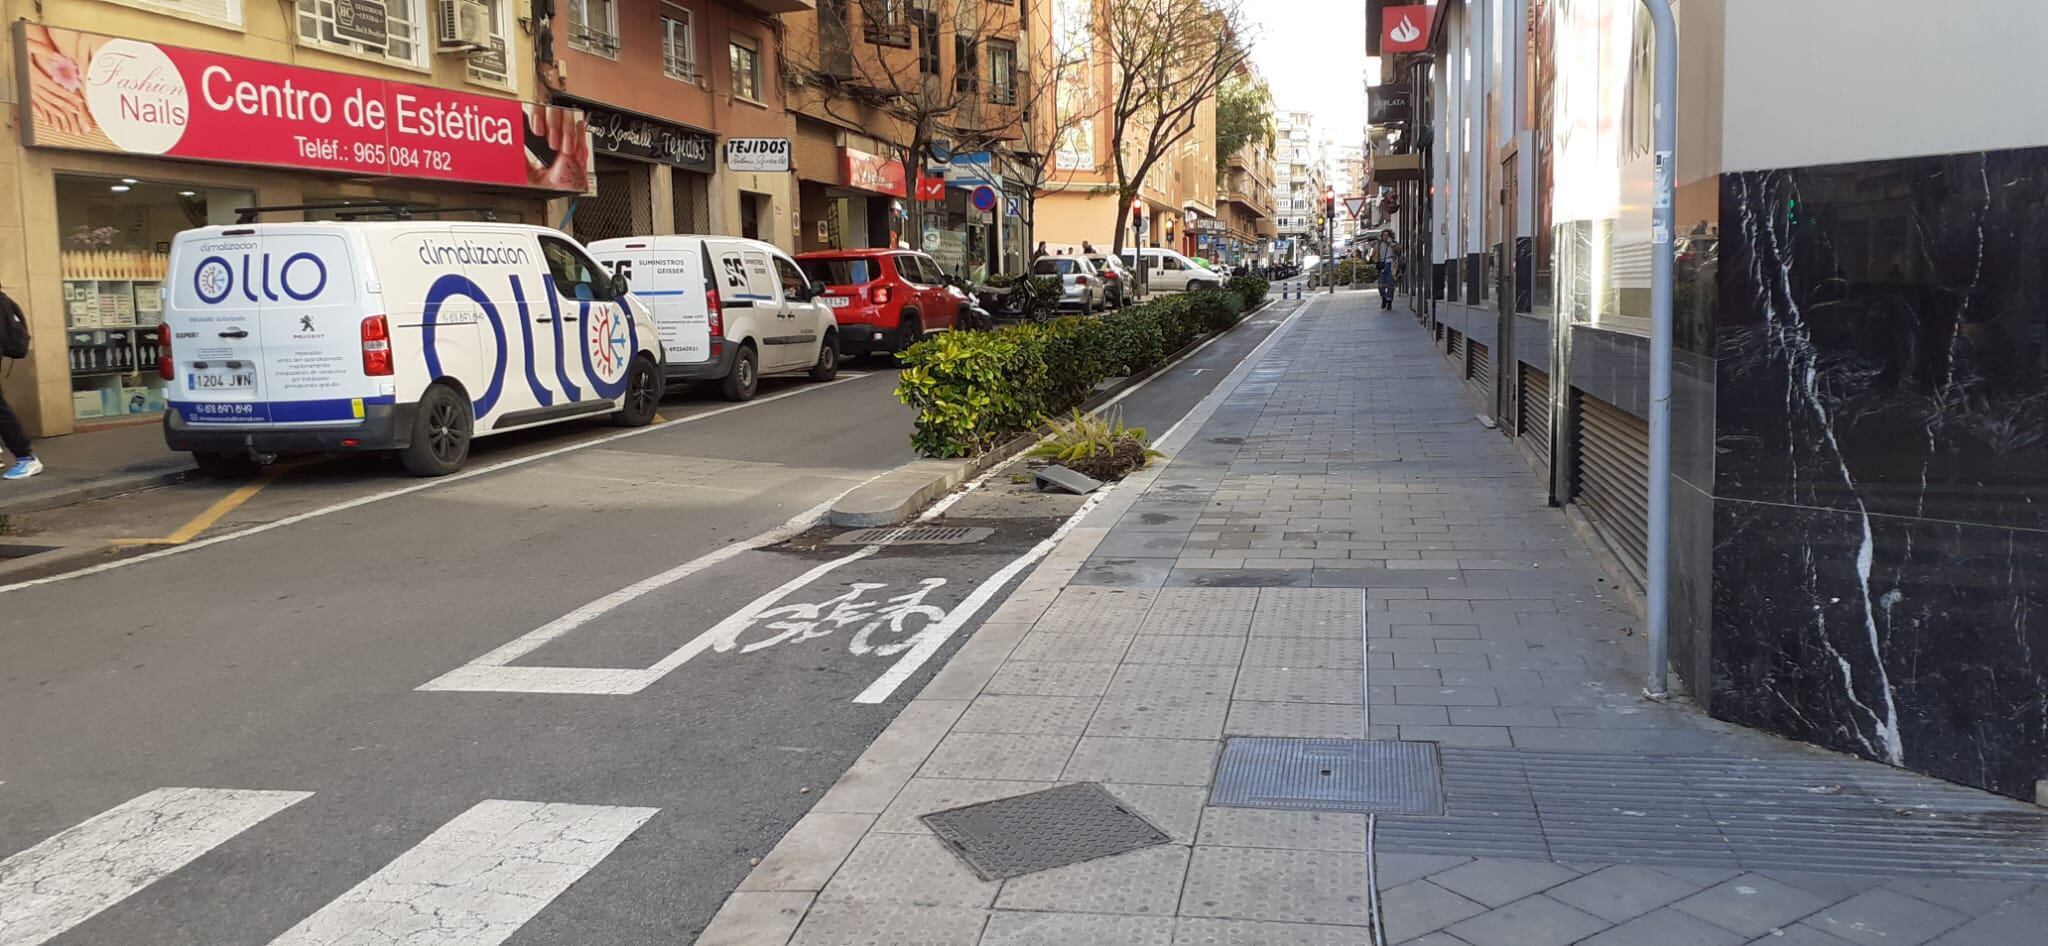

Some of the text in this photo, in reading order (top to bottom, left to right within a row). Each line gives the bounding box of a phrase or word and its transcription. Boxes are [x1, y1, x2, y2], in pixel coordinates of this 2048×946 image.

[340, 6, 354, 19] HC
[88, 52, 183, 96] Fashion
[120, 93, 185, 126] Nails
[201, 65, 513, 145] Centro de Estética
[354, 142, 385, 164] 965
[390, 146, 419, 168] 084
[423, 149, 452, 171] 782
[662, 132, 706, 162] Tejidos
[729, 140, 787, 154] TEJIDOS
[200, 241, 257, 252] climatizacion
[419, 240, 529, 265] climatizacion
[198, 375, 223, 387] 1204
